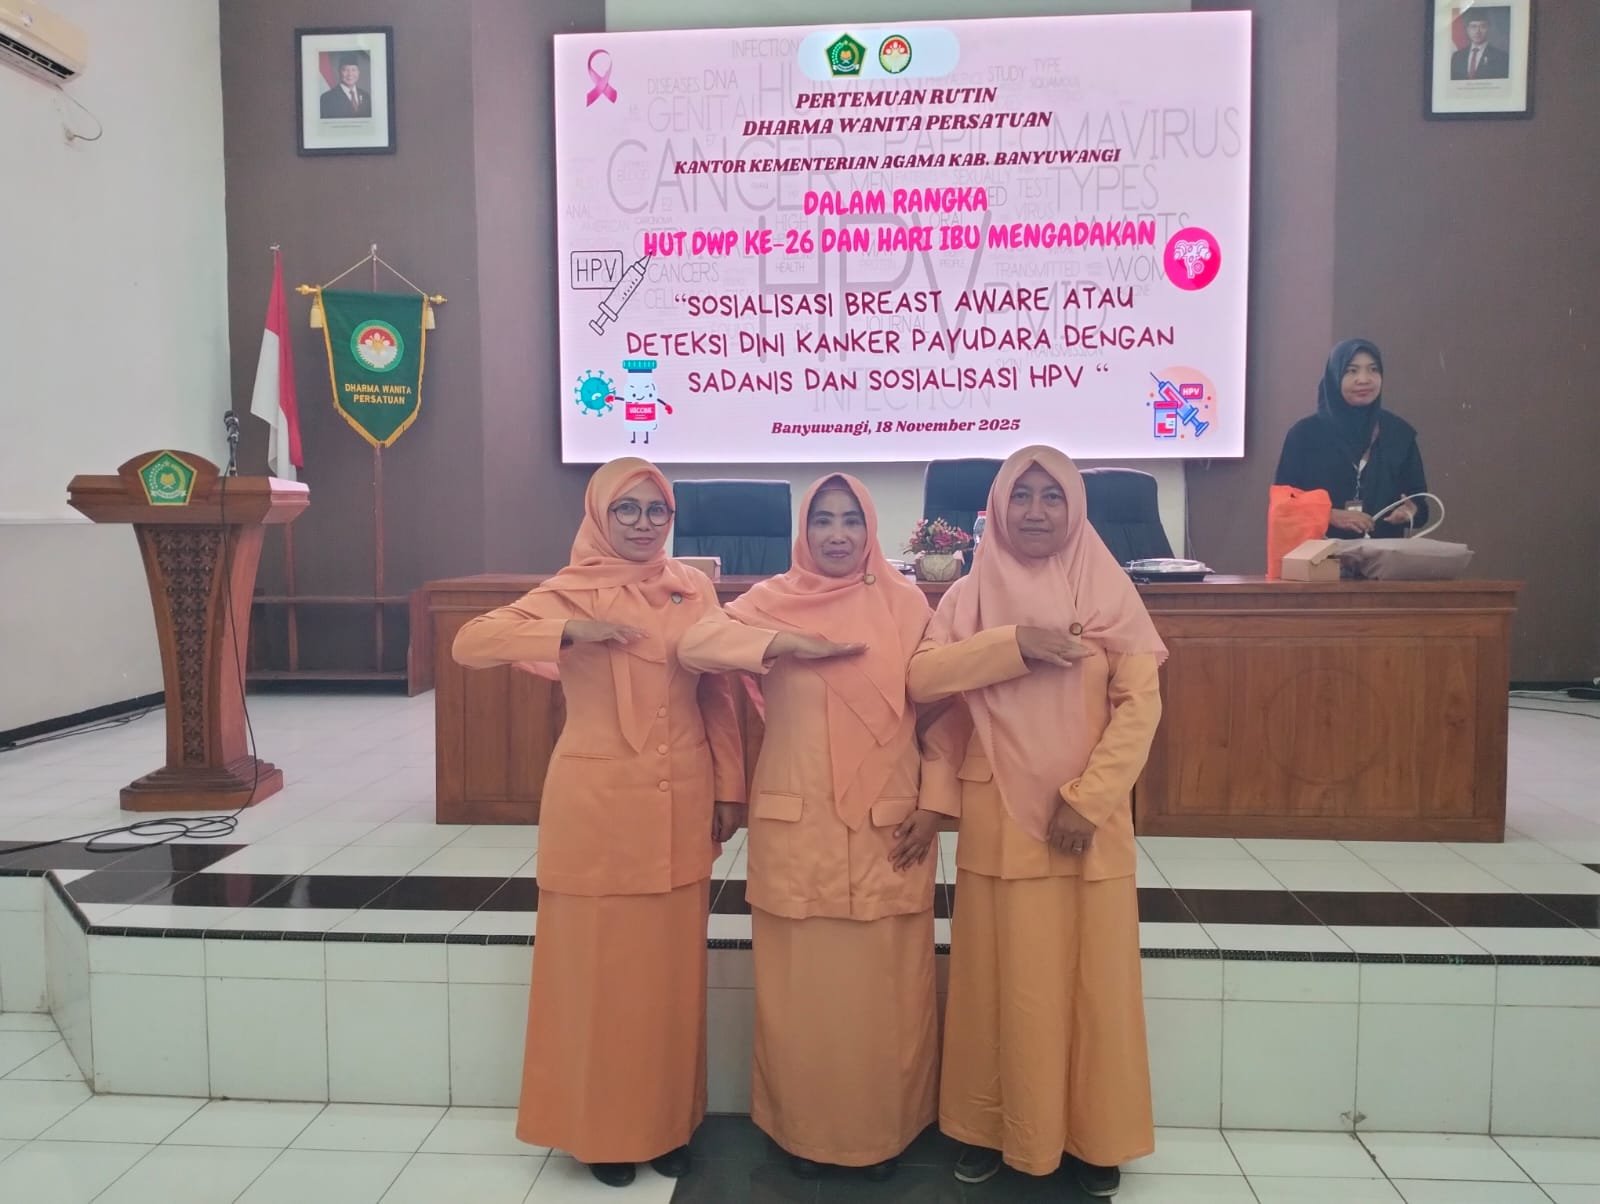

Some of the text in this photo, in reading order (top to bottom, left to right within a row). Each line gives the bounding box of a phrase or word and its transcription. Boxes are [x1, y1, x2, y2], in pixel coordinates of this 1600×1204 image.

[703, 69, 739, 91] DNA
[796, 87, 998, 109] PERTEMUAN RUTIN
[742, 111, 1053, 136] DHARMA WANITA PERSATUAN
[674, 149, 1122, 174] KANTOR KEMENTERIAN AGAMA KAB. BANYUWANGI
[607, 135, 850, 214] CANCER
[1048, 163, 1160, 211] TYPES
[804, 189, 886, 216] DALAM
[893, 186, 988, 214] RANGKA
[644, 232, 687, 257] HUT
[692, 231, 739, 256] DWP
[745, 229, 814, 255] KE-26
[821, 228, 870, 254] DAN
[877, 225, 932, 252] HARI
[939, 223, 981, 251] IBU
[988, 220, 1156, 249] MENGADAKAN
[575, 257, 618, 283] HPV
[648, 262, 720, 283] CANCERS
[759, 215, 992, 363] HPV
[845, 290, 942, 316] BREAST
[955, 287, 1050, 314] AWARE
[1063, 286, 1134, 310] ATAU
[626, 325, 1175, 358] DETEKSI DINI KANKER PAYUDARA DENGAN
[344, 383, 412, 395] DHARMA WANITA
[688, 368, 793, 395] SADANIS
[804, 367, 857, 391] DAN
[869, 366, 1017, 393] SOSIALISASI
[1030, 364, 1084, 389] HPV
[1182, 387, 1200, 397] HPV
[353, 394, 406, 405] PERSATUAN
[771, 418, 1022, 437] Banyuwangi, 18 November 2025
